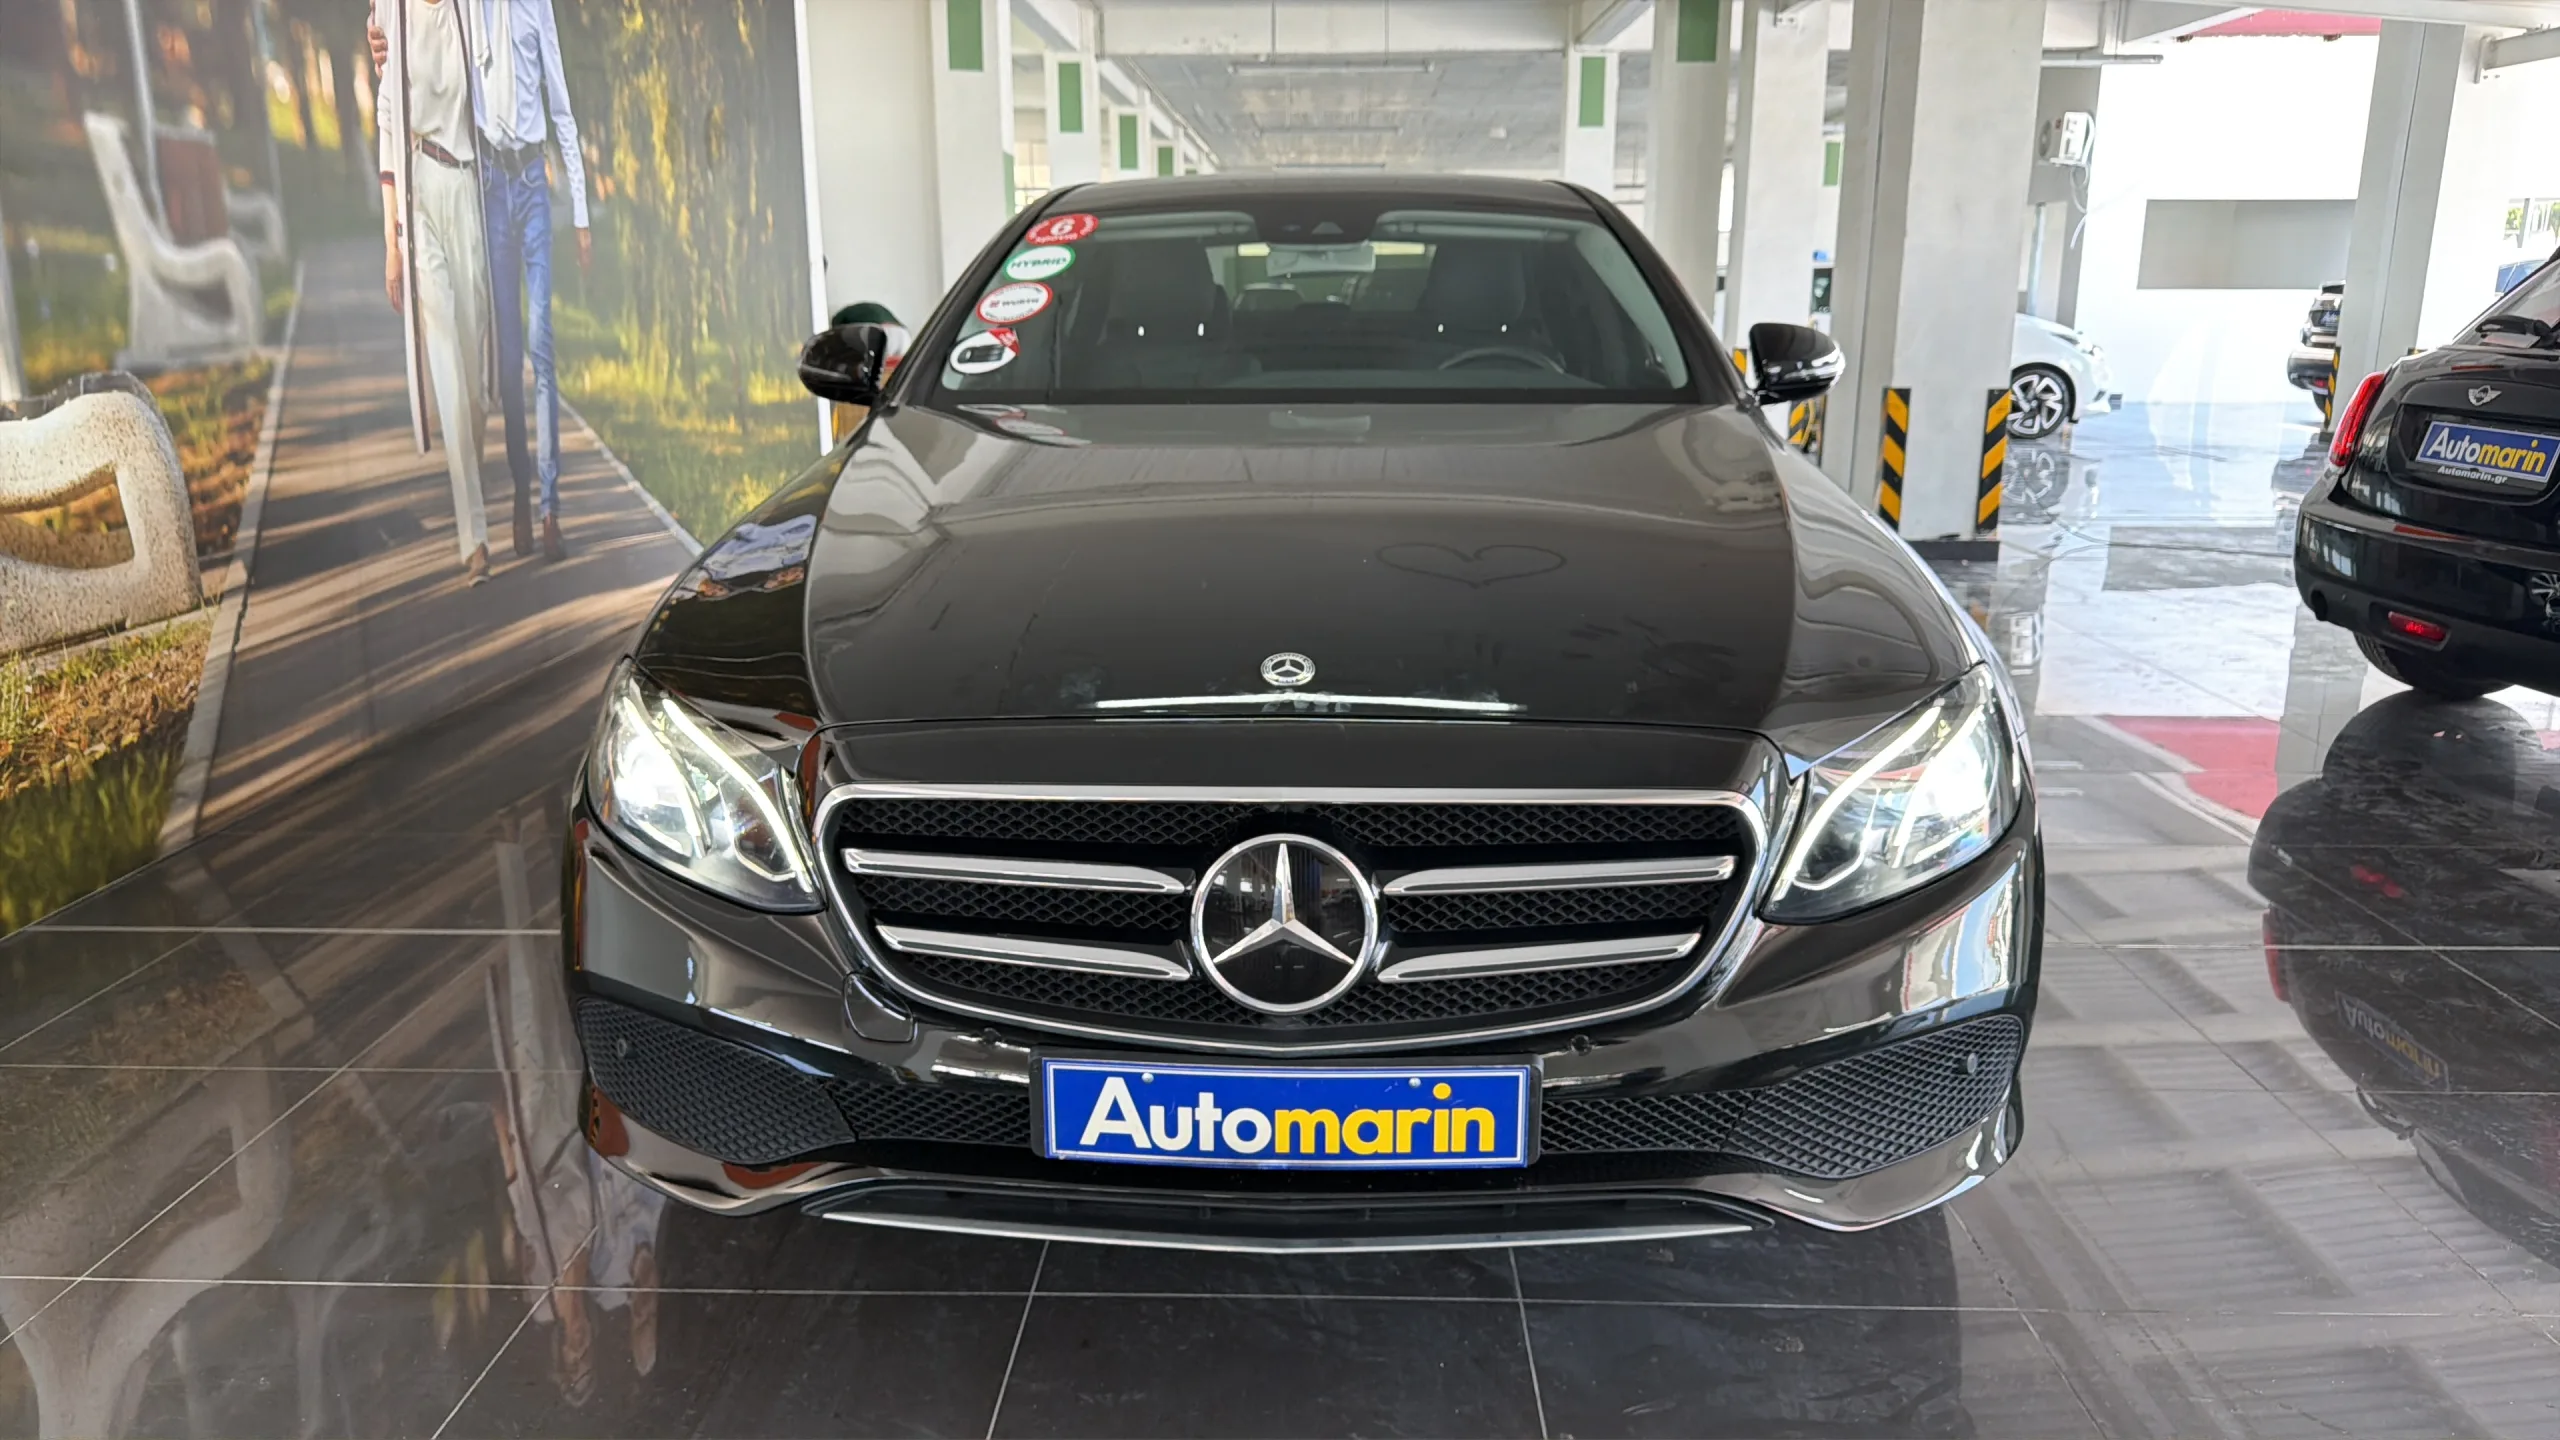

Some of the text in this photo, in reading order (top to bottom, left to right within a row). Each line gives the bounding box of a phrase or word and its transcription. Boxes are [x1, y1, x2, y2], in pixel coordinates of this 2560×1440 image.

[1050, 218, 1075, 235] 6
[1011, 257, 1067, 269] HYBRID
[2426, 427, 2547, 474] Automarin
[2438, 465, 2508, 484] Automarin.gr
[1079, 1076, 1496, 1155] Automarin
